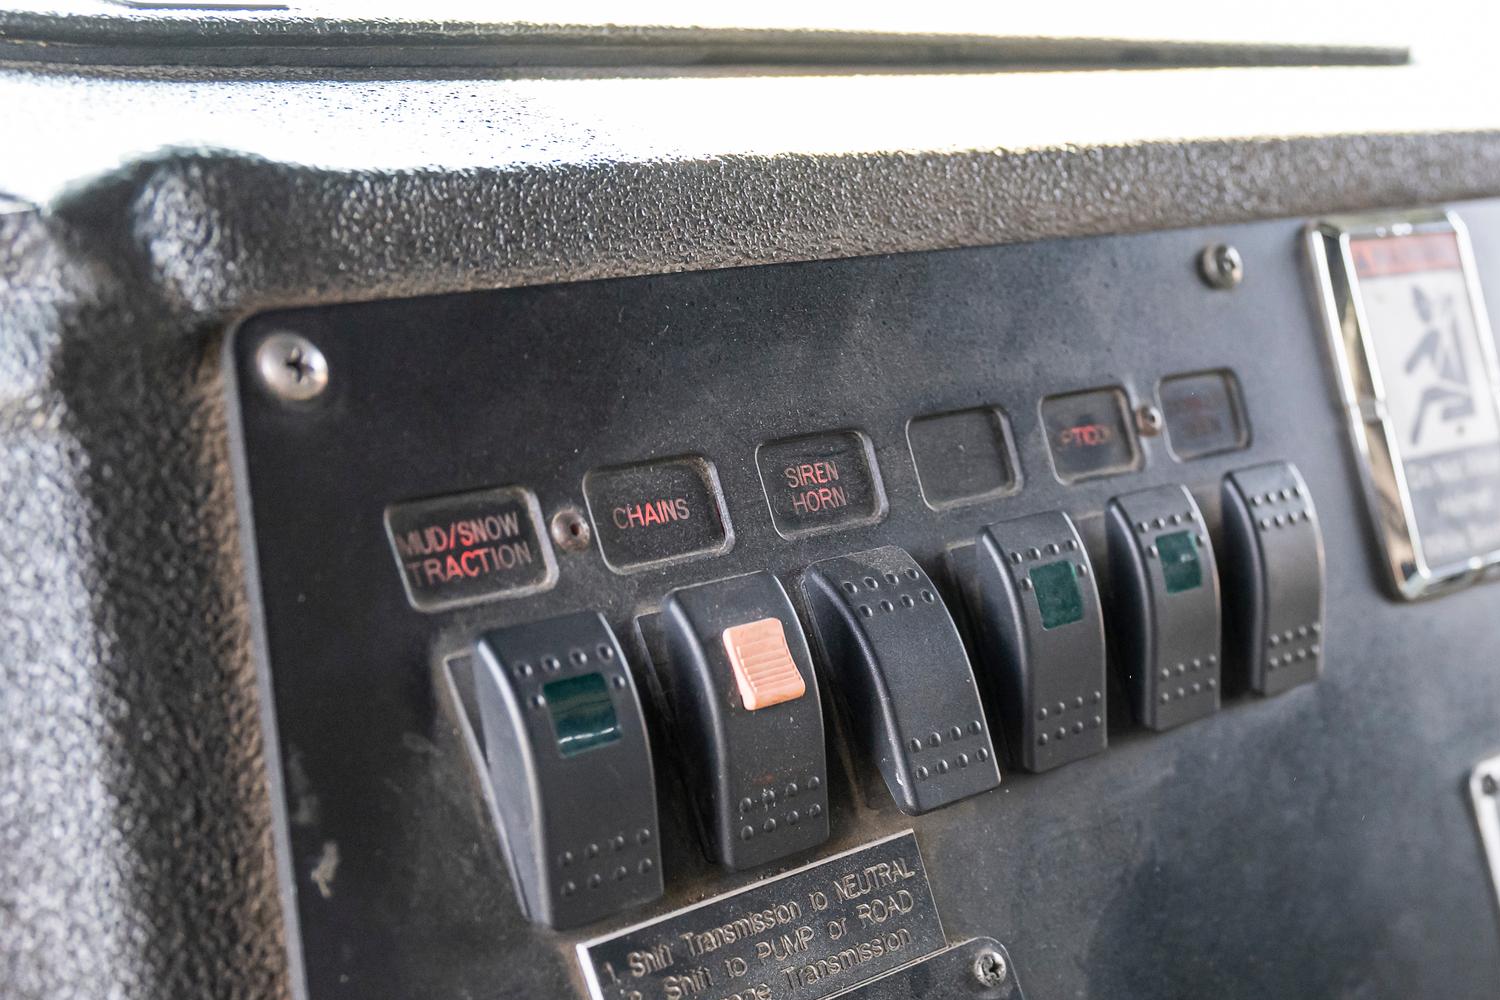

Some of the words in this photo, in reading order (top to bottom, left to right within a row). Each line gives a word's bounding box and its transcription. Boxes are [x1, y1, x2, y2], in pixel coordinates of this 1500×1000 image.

[785, 461, 839, 488] SIREN
[612, 499, 690, 530] CHAINS
[793, 486, 846, 513] HORN
[396, 511, 519, 556] MUD/SNOW
[406, 541, 532, 586] TRACTION
[628, 943, 674, 977] Shift
[680, 901, 801, 957] Transmission
[809, 891, 828, 912] to
[833, 858, 915, 903] NEUTRAL
[663, 966, 713, 1000] Shift
[724, 957, 748, 979] to
[755, 926, 815, 965] PUMP
[827, 917, 847, 940] or
[855, 890, 914, 928] ROAD
[780, 929, 911, 990] Transmission
